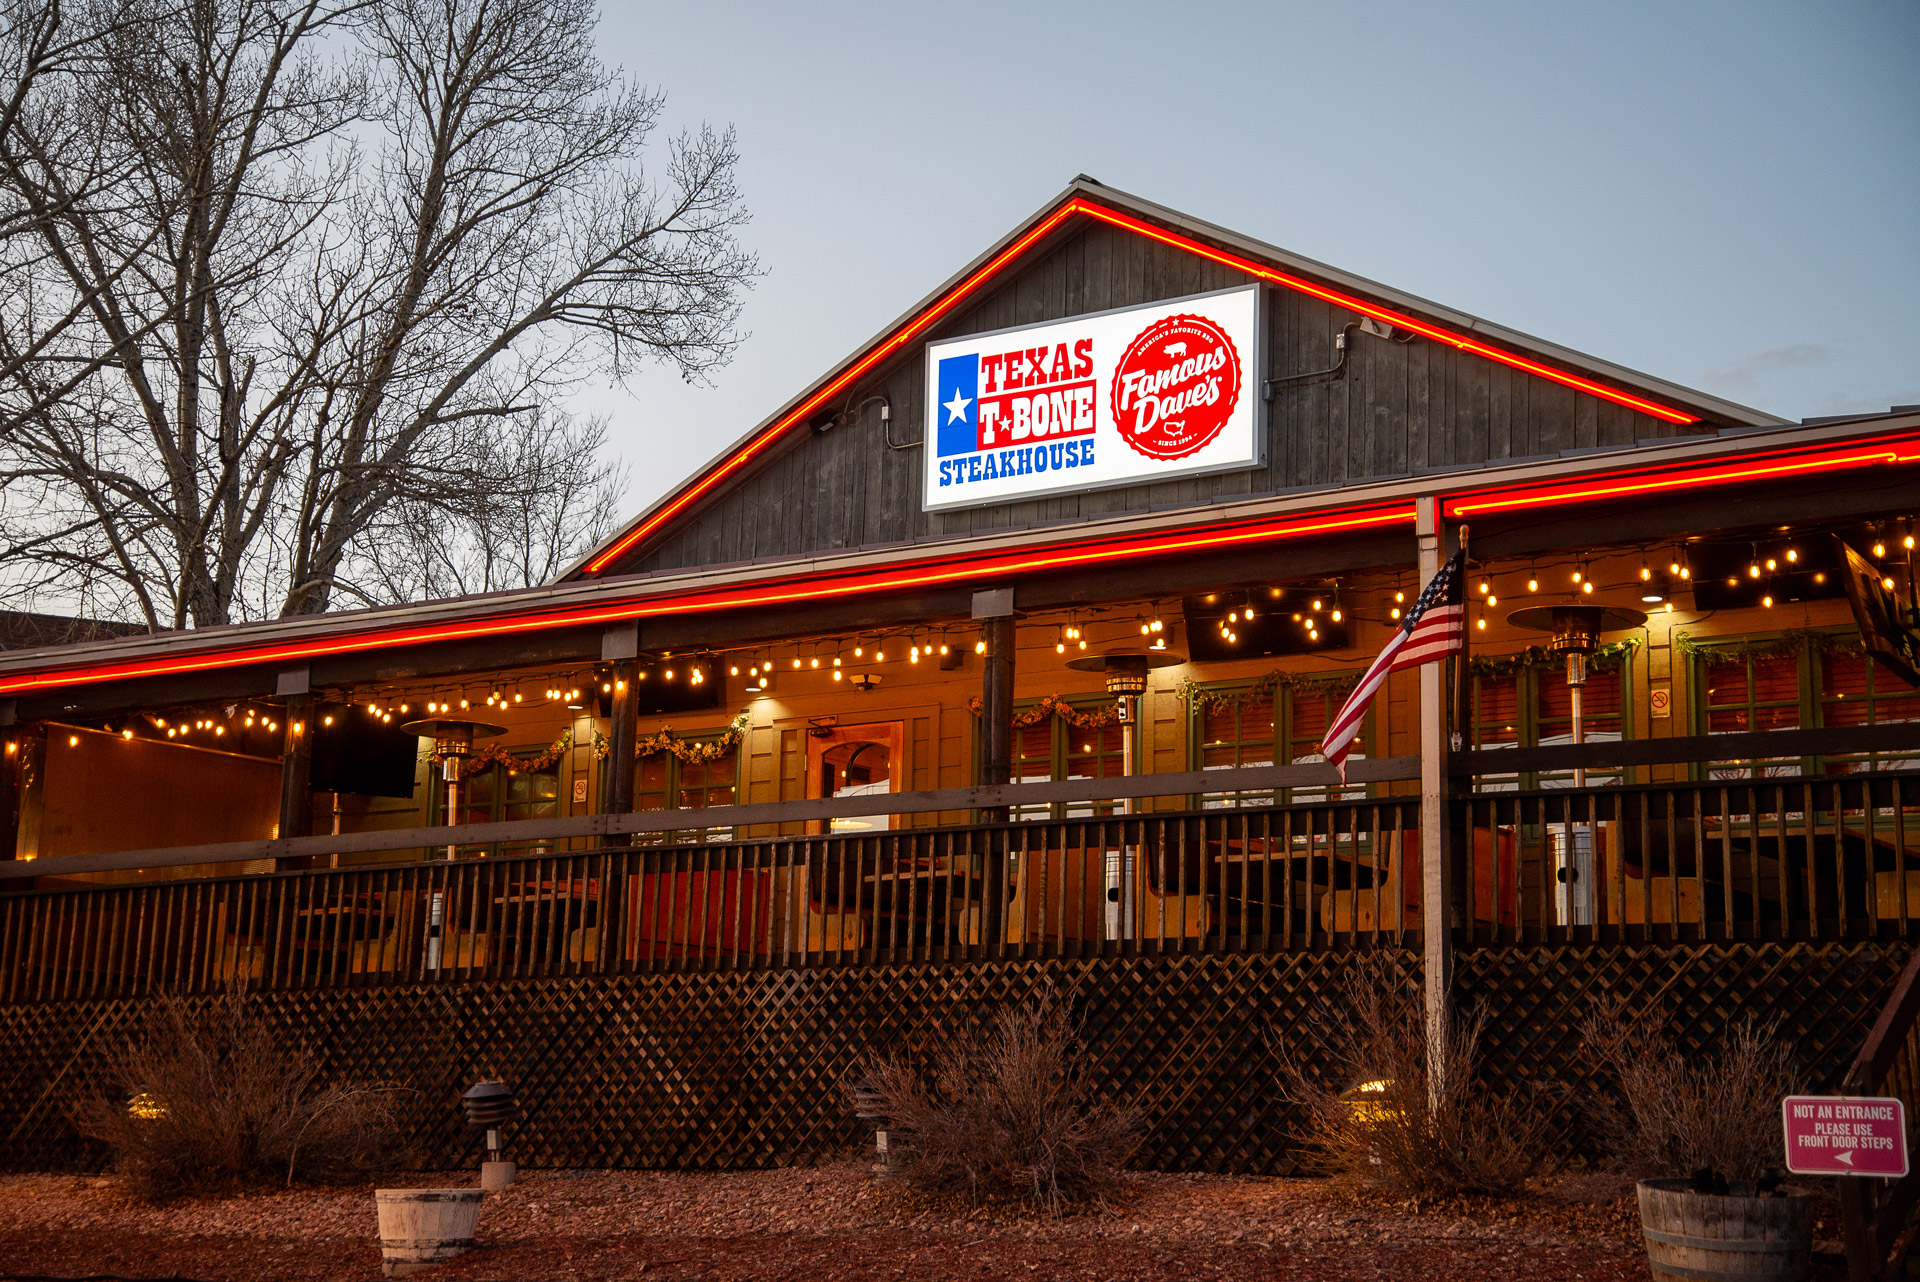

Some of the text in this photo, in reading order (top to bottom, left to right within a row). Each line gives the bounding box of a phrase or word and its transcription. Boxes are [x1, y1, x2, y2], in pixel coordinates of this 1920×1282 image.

[981, 338, 1094, 394] TEXAS
[1120, 346, 1226, 411] Famous
[1133, 374, 1220, 435] Dave's
[939, 438, 1095, 487] STEAKHOUSE
[1793, 1105, 1894, 1120] NOT AN ENTRANCE
[1815, 1123, 1874, 1136] PLEASE USE
[1798, 1135, 1894, 1150] FRONT DOOR STEPS
